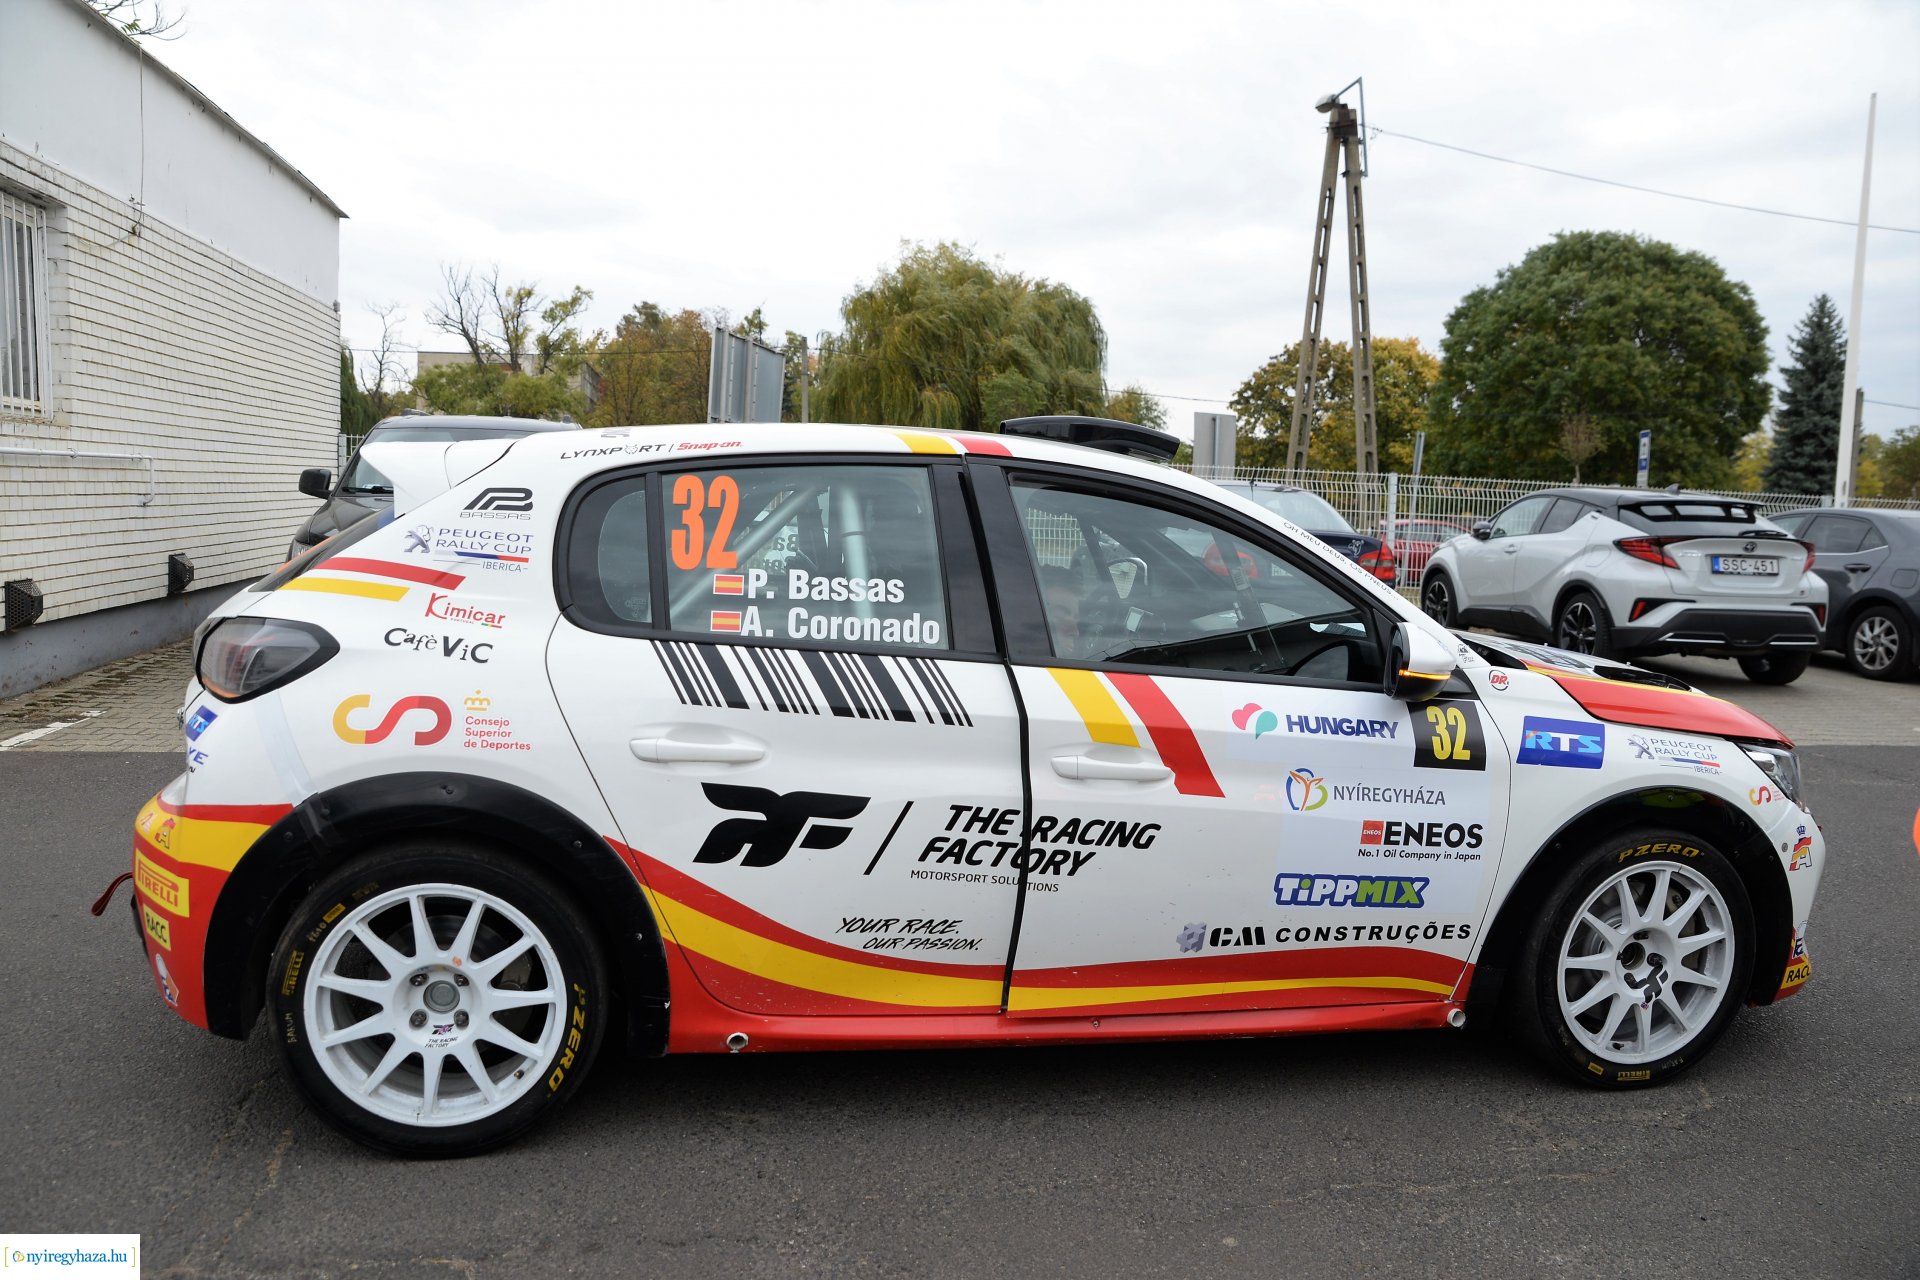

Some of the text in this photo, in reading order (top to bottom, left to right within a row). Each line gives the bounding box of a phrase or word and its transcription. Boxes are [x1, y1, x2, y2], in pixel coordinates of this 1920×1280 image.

[676, 440, 743, 451] Snap-on
[459, 511, 532, 521] BASSAS
[671, 474, 740, 570] 32
[439, 528, 534, 543] PEUGEOT
[1283, 522, 1298, 533] OH
[436, 539, 532, 554] RALLY CUP
[482, 561, 522, 572] IBERICA
[1722, 559, 1774, 572] SSC-451
[748, 568, 905, 603] P. Bassas
[425, 593, 506, 624] Kimicar
[740, 605, 940, 644] A. Coronado
[442, 635, 493, 663] ViC
[465, 716, 510, 727] Consejo
[1286, 714, 1398, 739] HUNGARY
[465, 727, 512, 738] Superior
[1426, 705, 1471, 761] 32
[464, 739, 531, 751] de Deportes
[1525, 729, 1603, 754] RTS
[1650, 738, 1713, 752] PEUGEOT
[1654, 747, 1718, 760] RALLY CUP
[1333, 783, 1446, 805] NYÍREGYHÁZA
[944, 804, 1162, 849] THE RACING
[1383, 821, 1484, 849] ENEOS
[918, 836, 1097, 876] FACTORY
[1358, 848, 1481, 862] No.1 Oil Company in Japan
[138, 858, 180, 907] PIRELLI
[910, 870, 989, 884] MOTORSPORT
[835, 917, 963, 935] YOUR RACE.
[1275, 921, 1471, 943] CONSTRUÇÕES
[863, 937, 983, 951] OUR PASSION.
